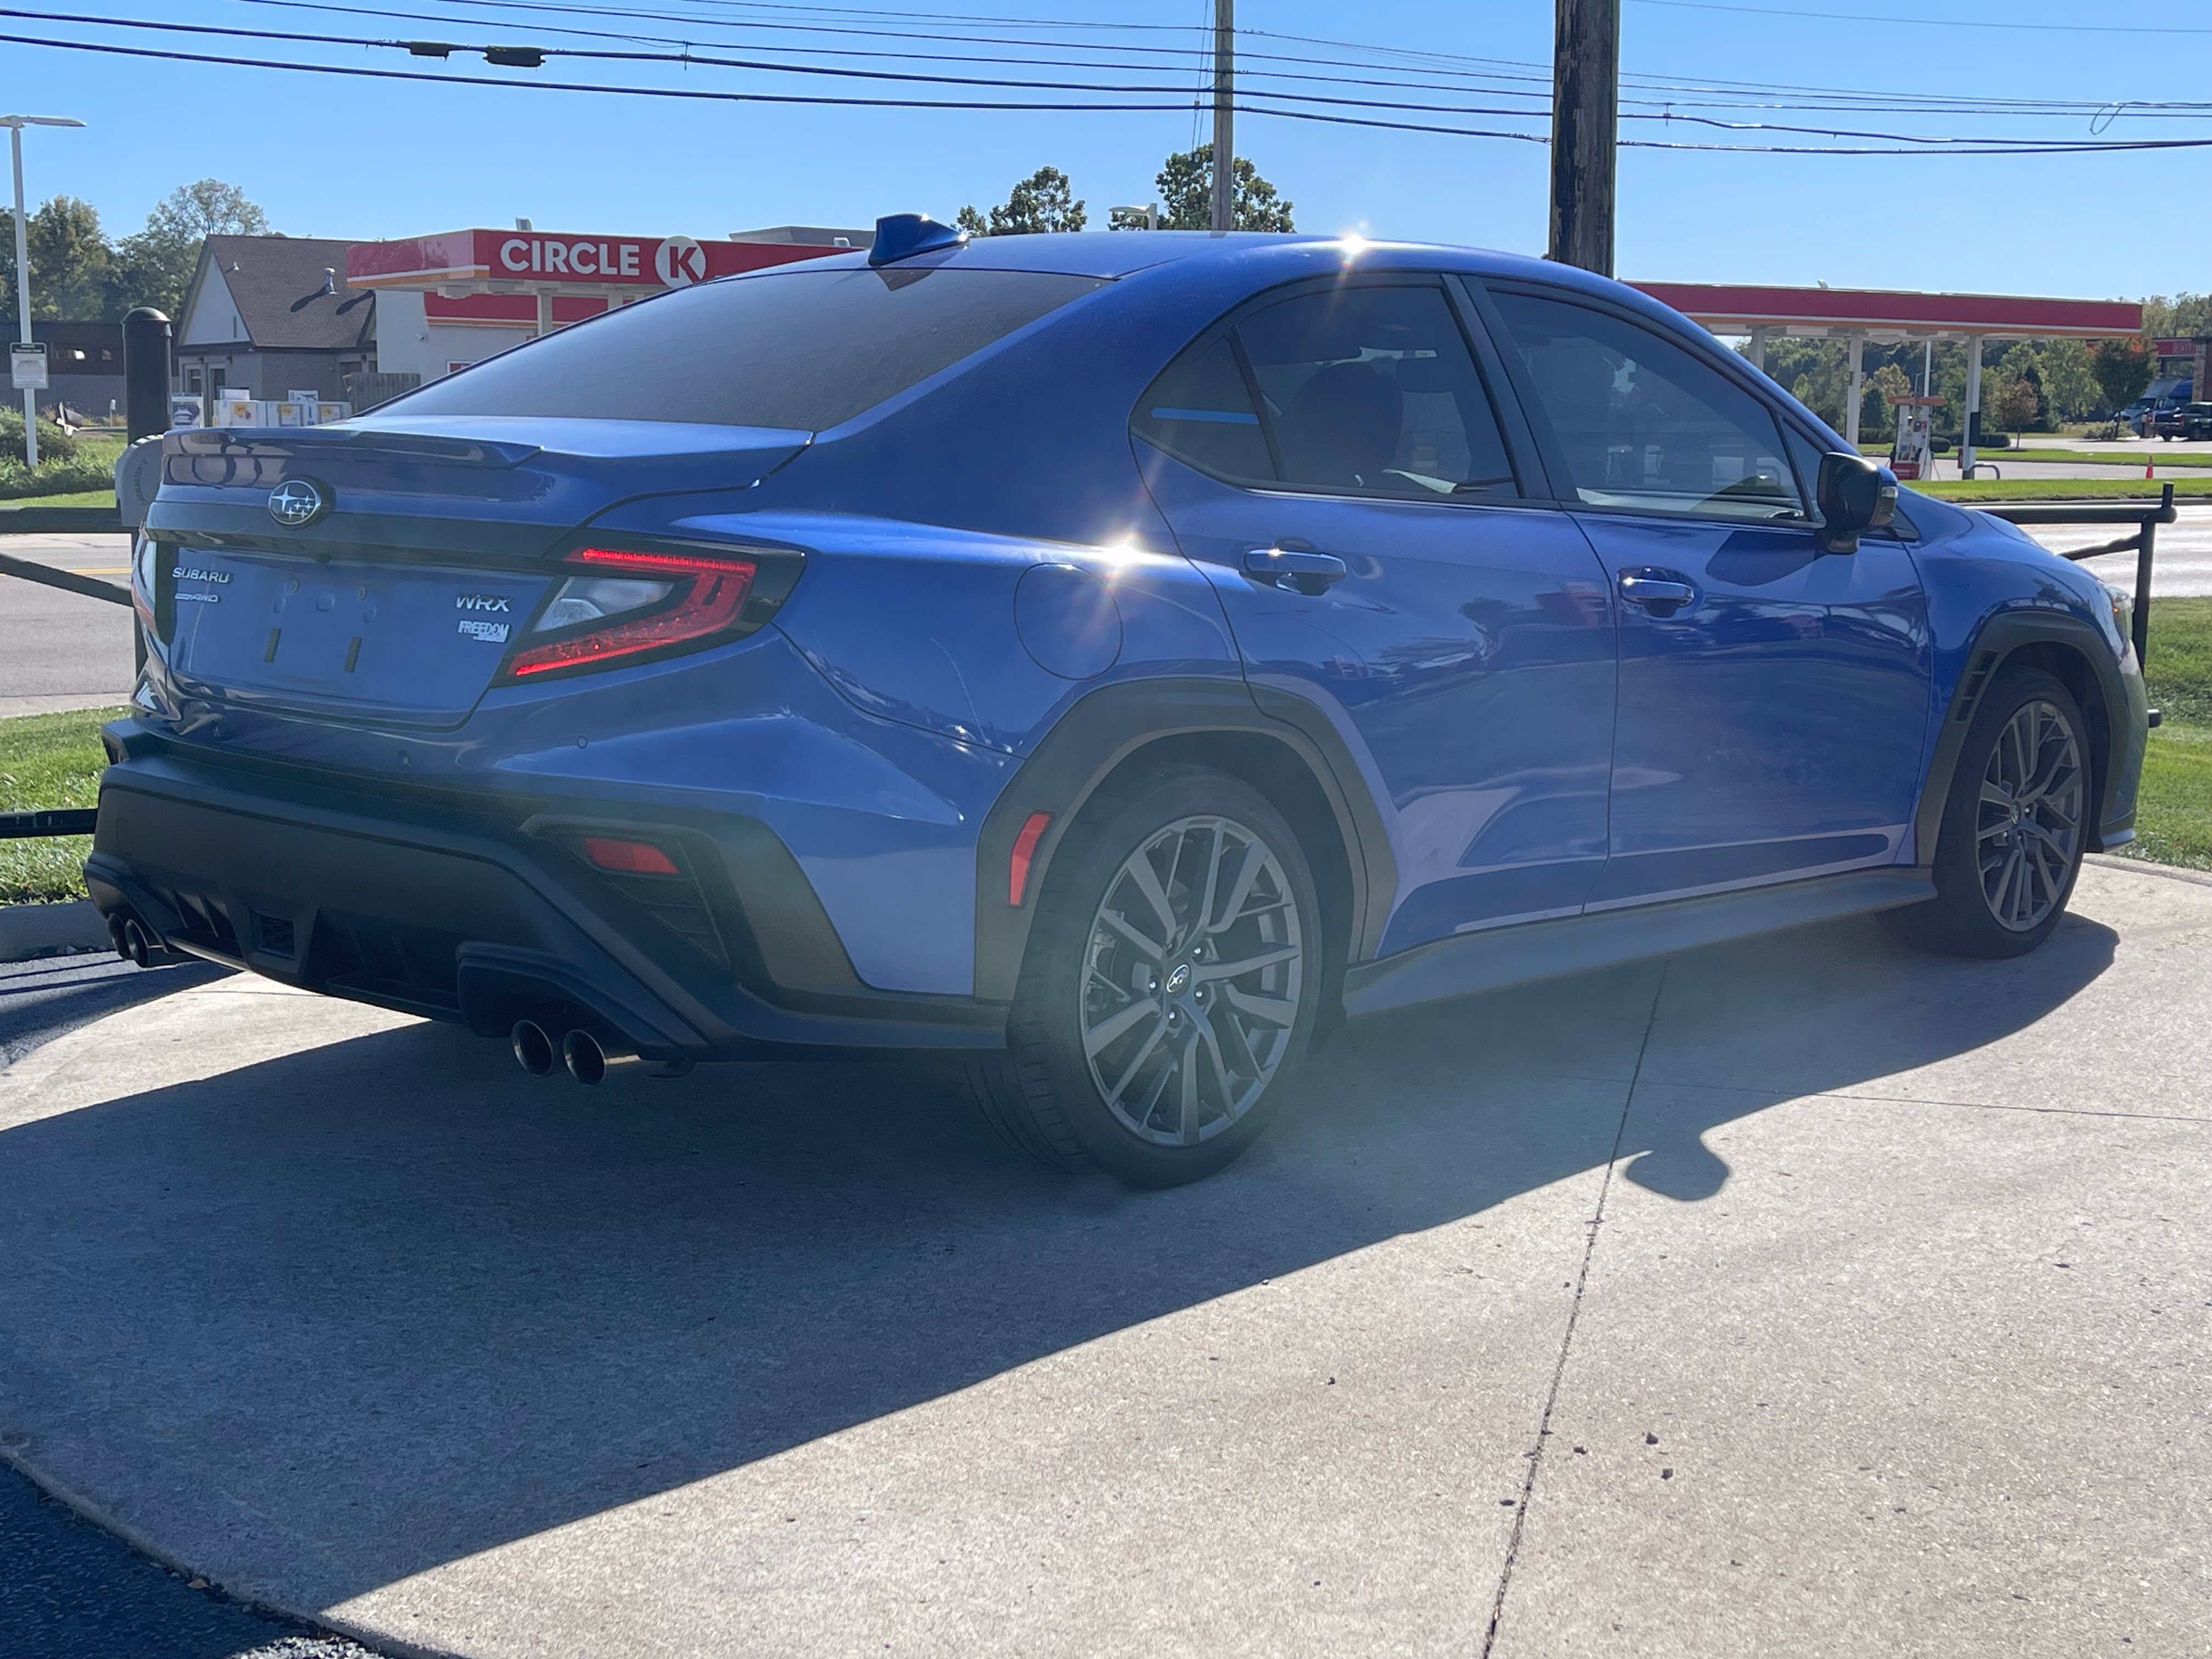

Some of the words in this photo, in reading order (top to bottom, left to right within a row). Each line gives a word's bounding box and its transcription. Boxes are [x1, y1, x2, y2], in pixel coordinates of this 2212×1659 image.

[500, 239, 640, 275] CIRCLE
[669, 246, 702, 283] K
[172, 567, 230, 583] SUBARU
[190, 594, 218, 603] AWD
[456, 595, 511, 612] WRX
[458, 620, 510, 637] FREEDOM
